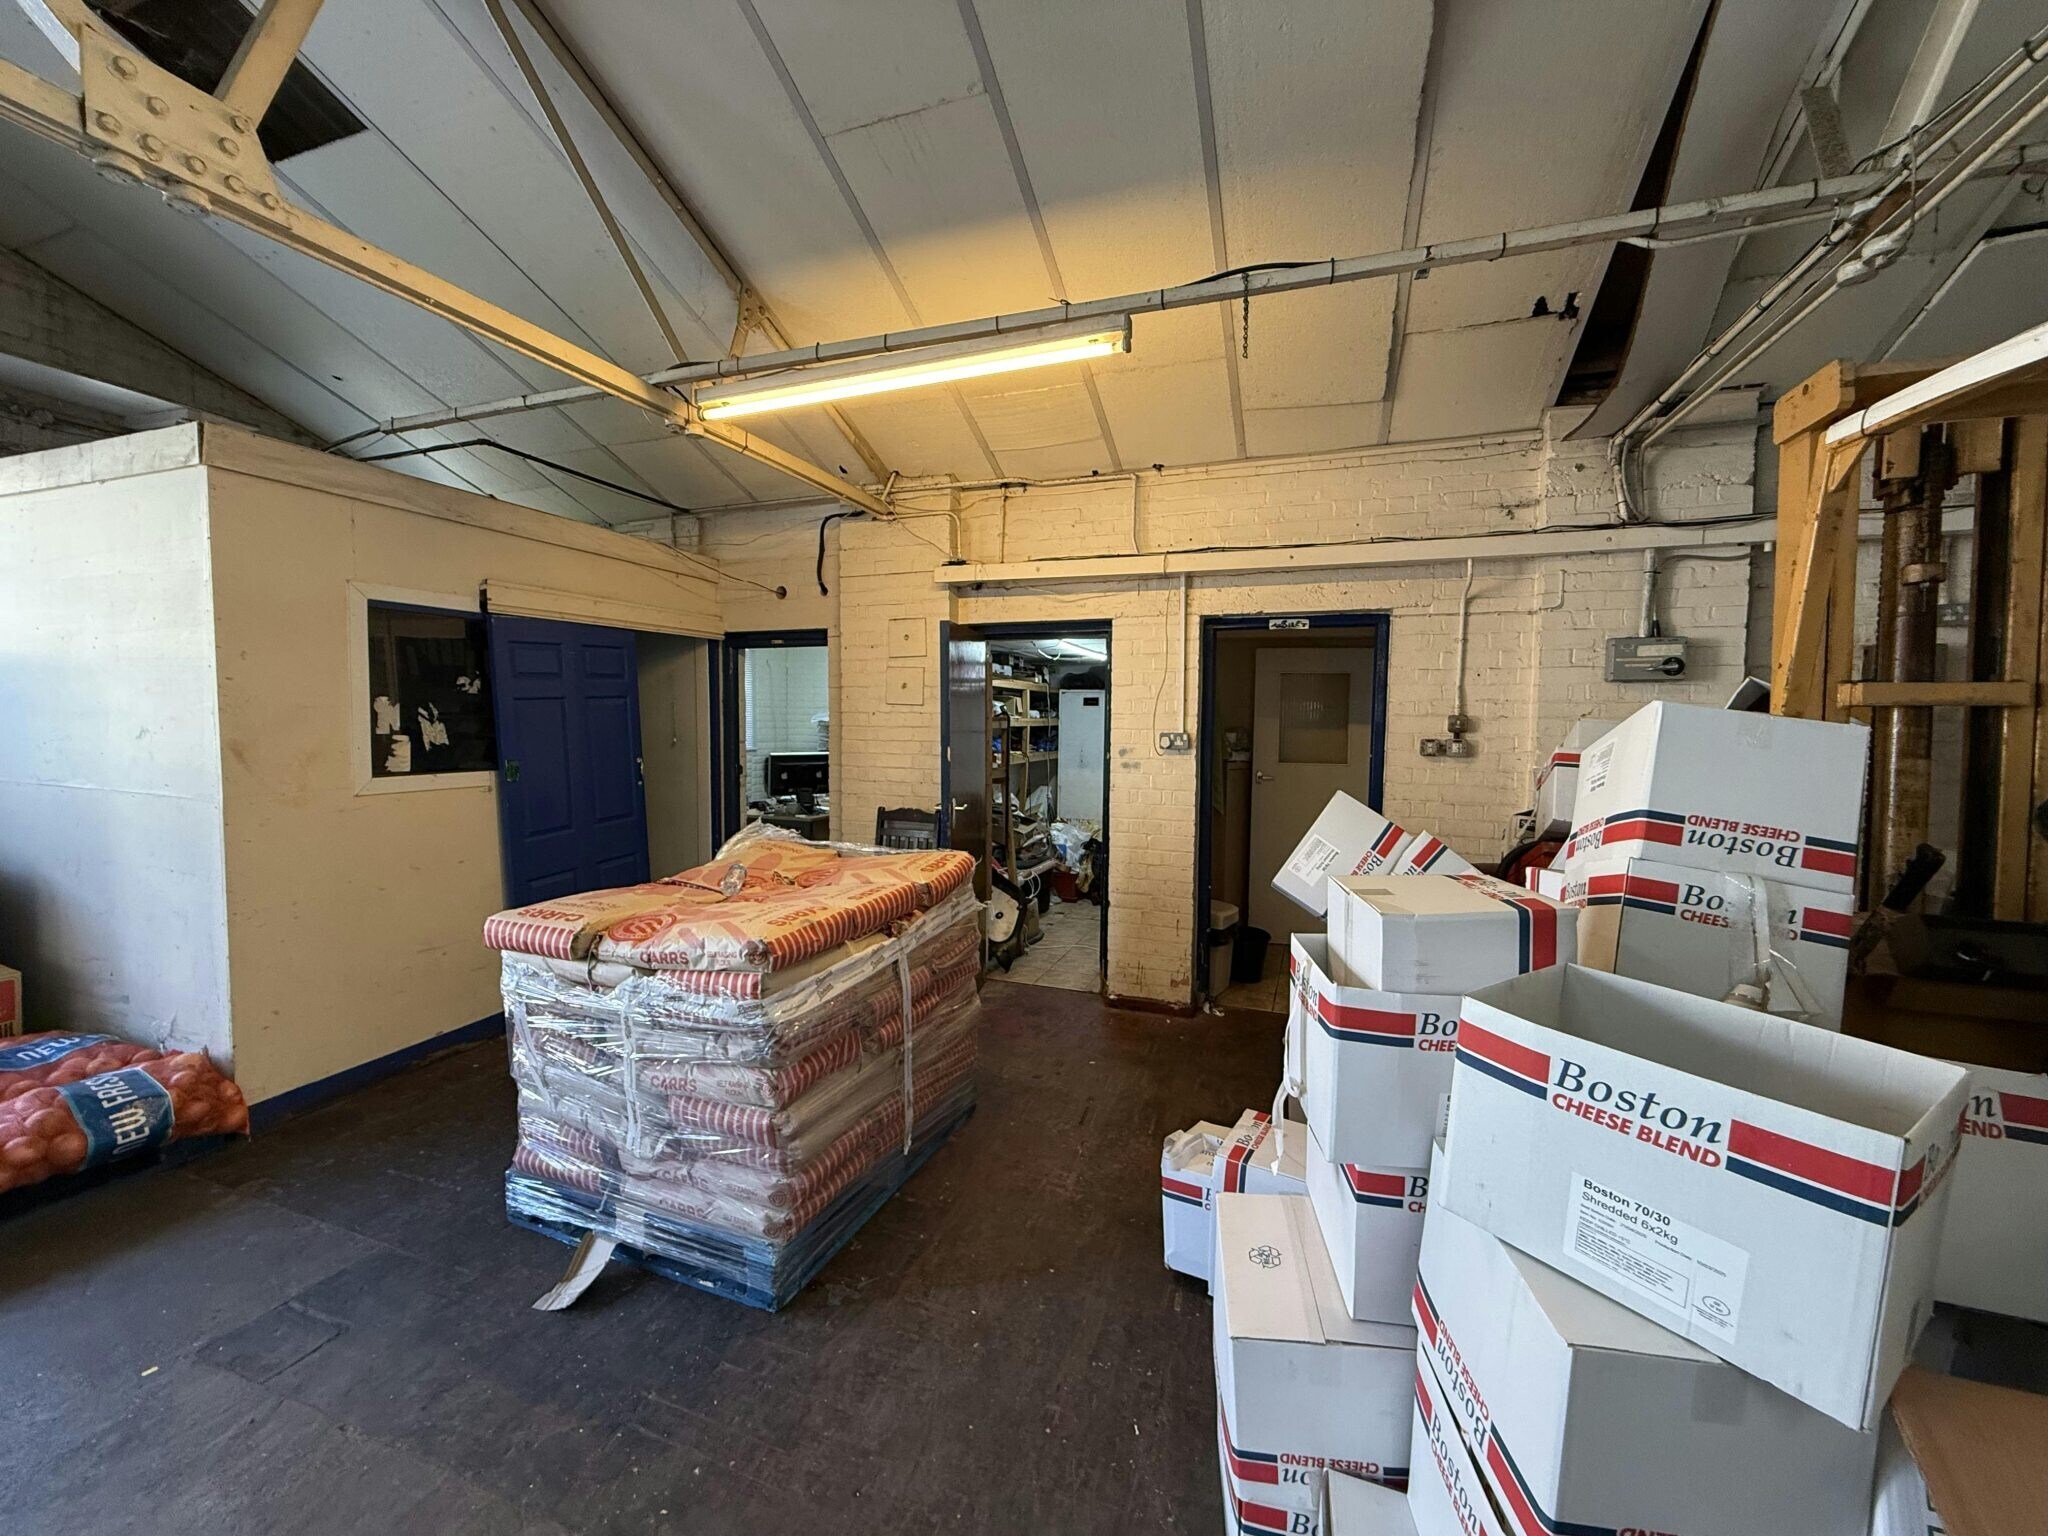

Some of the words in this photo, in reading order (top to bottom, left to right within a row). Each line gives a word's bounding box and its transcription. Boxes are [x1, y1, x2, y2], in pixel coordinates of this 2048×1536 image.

[1687, 814, 1740, 832] BLEND
[1741, 823, 1801, 842] CHEESE
[1362, 855, 1384, 876] Bos
[1687, 829, 1800, 868] Boston
[1680, 909, 1730, 929] CHEES
[1418, 1039, 1456, 1052] CHEE
[86, 1074, 138, 1109] FRES
[1553, 1057, 1722, 1144] Boston
[1552, 1093, 1633, 1135] CHEESE
[1636, 1124, 1722, 1168] BLEND
[1957, 1119, 2002, 1139] END
[1581, 1191, 1638, 1225] Shredded
[1641, 1220, 1679, 1246] 6x2kg
[1583, 1178, 1630, 1209] Boston
[1634, 1202, 1671, 1226] 70/30
[1440, 1320, 1461, 1367] BLEND
[1437, 1337, 1487, 1453] Boston
[1461, 1362, 1489, 1421] CHEESE
[1280, 1453, 1325, 1469] BLEND
[1329, 1458, 1380, 1475] CHEESE
[1432, 1409, 1477, 1535] Boston
